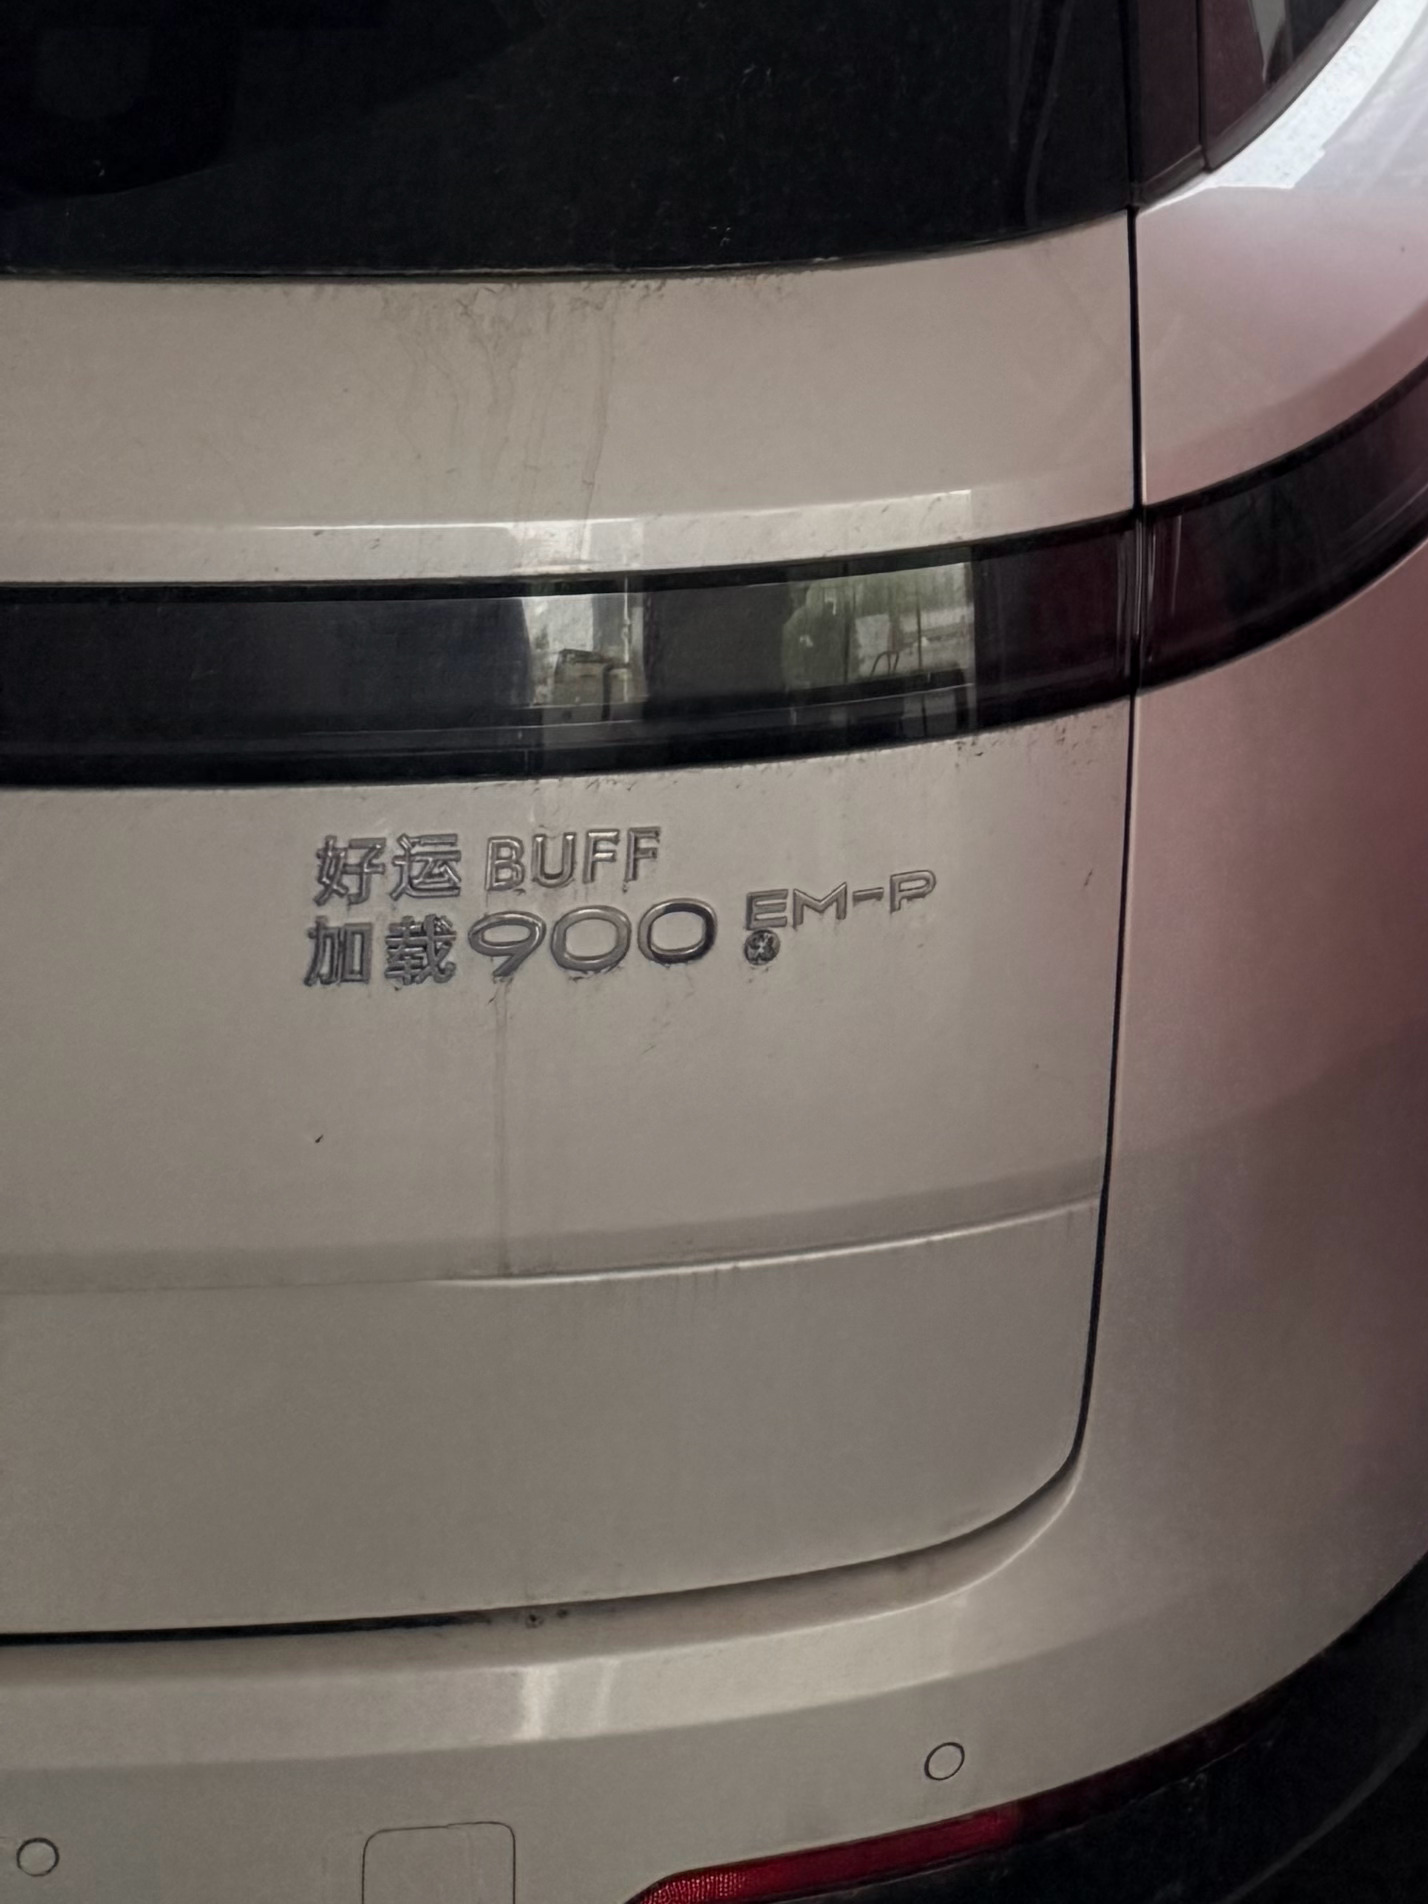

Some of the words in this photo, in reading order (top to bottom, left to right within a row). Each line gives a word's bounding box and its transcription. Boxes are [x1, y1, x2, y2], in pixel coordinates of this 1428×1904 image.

[313, 833, 463, 906] 好运
[485, 826, 663, 892] BUFF
[745, 868, 938, 931] EM-P
[303, 914, 459, 989] 加载
[467, 896, 719, 980] 900
